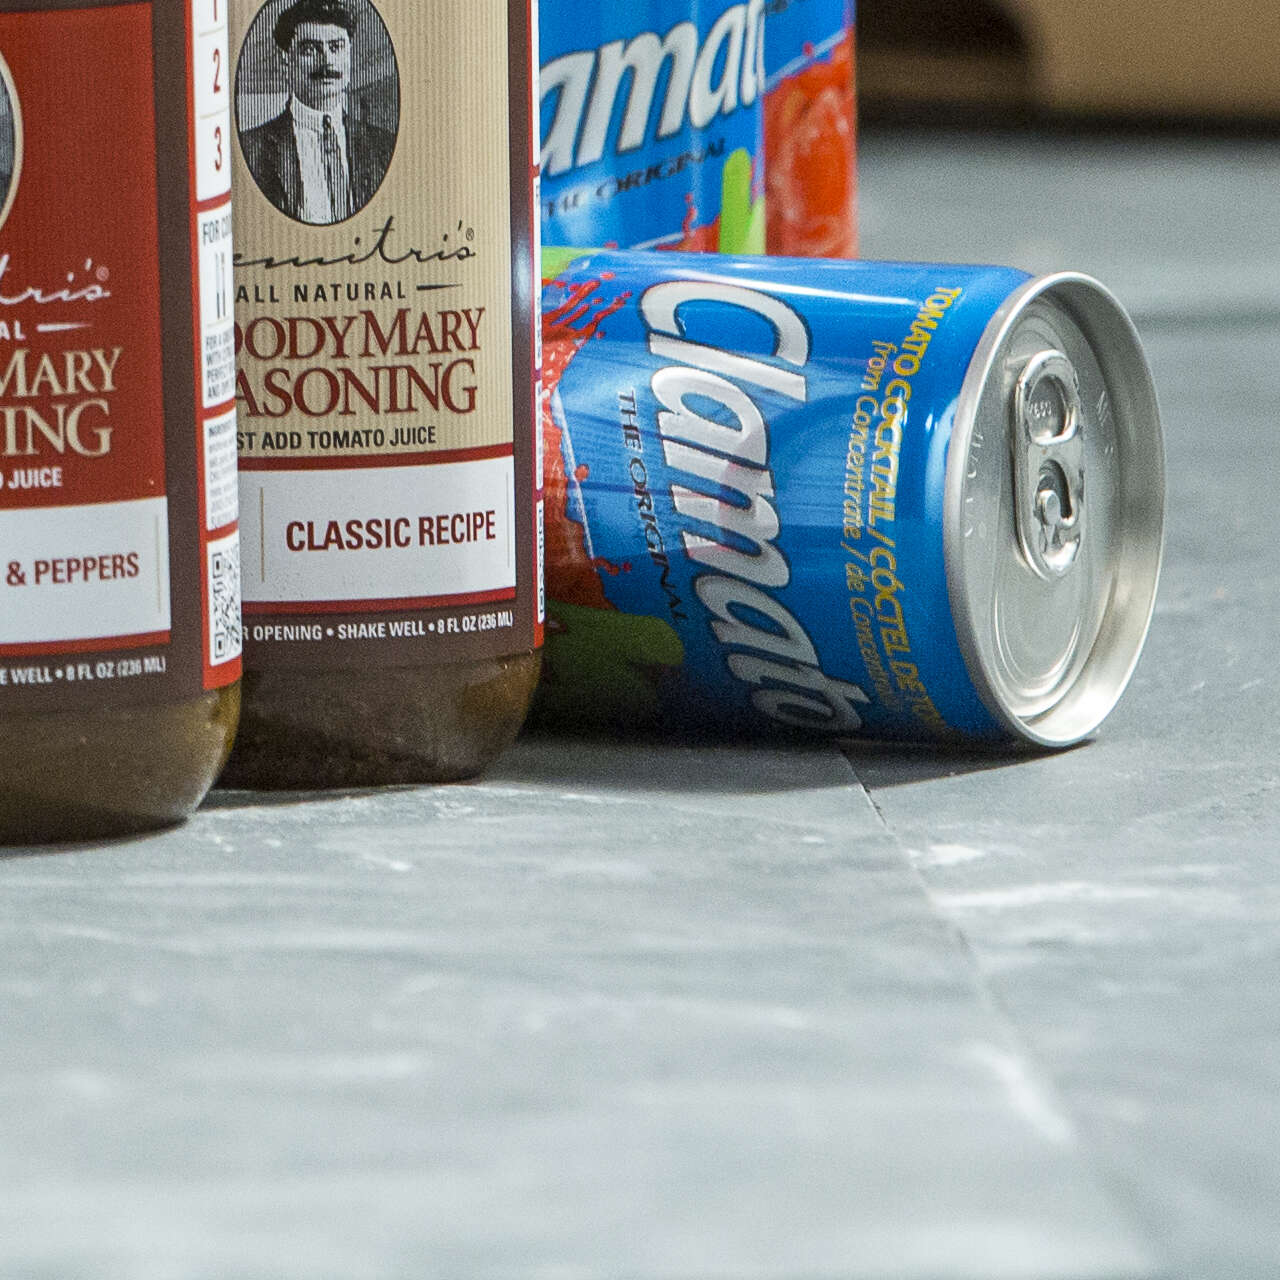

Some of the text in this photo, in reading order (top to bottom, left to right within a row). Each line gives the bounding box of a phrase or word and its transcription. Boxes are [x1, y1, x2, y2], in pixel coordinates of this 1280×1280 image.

[213, 48, 222, 94] 2
[214, 125, 223, 172] 3
[239, 280, 407, 303] ALL NATURAL
[894, 286, 962, 377] TOMATO
[235, 359, 478, 419] ASONING
[861, 338, 898, 393] from
[262, 425, 437, 450] ADD TOMATO JUICE
[868, 378, 913, 525] COCKTAIL
[8, 467, 63, 489] JUICE
[844, 395, 880, 539] Concentrate
[617, 388, 690, 623] THE ORIGINAL
[640, 279, 866, 733] Clamato
[286, 510, 496, 552] CLASSIC RECIPE
[6, 561, 28, 587] &
[35, 551, 141, 587] PEPPERS
[252, 622, 322, 642] OPENING
[337, 621, 387, 640] SHAKE
[389, 619, 426, 638] WELL
[436, 617, 446, 635] 8
[447, 616, 460, 634] FL
[461, 614, 477, 633] OZ
[869, 547, 911, 666] CÓCTEL
[10, 665, 54, 686] WELL
[65, 661, 75, 682] 8
[77, 660, 94, 681] FL
[96, 660, 114, 680] OZ
